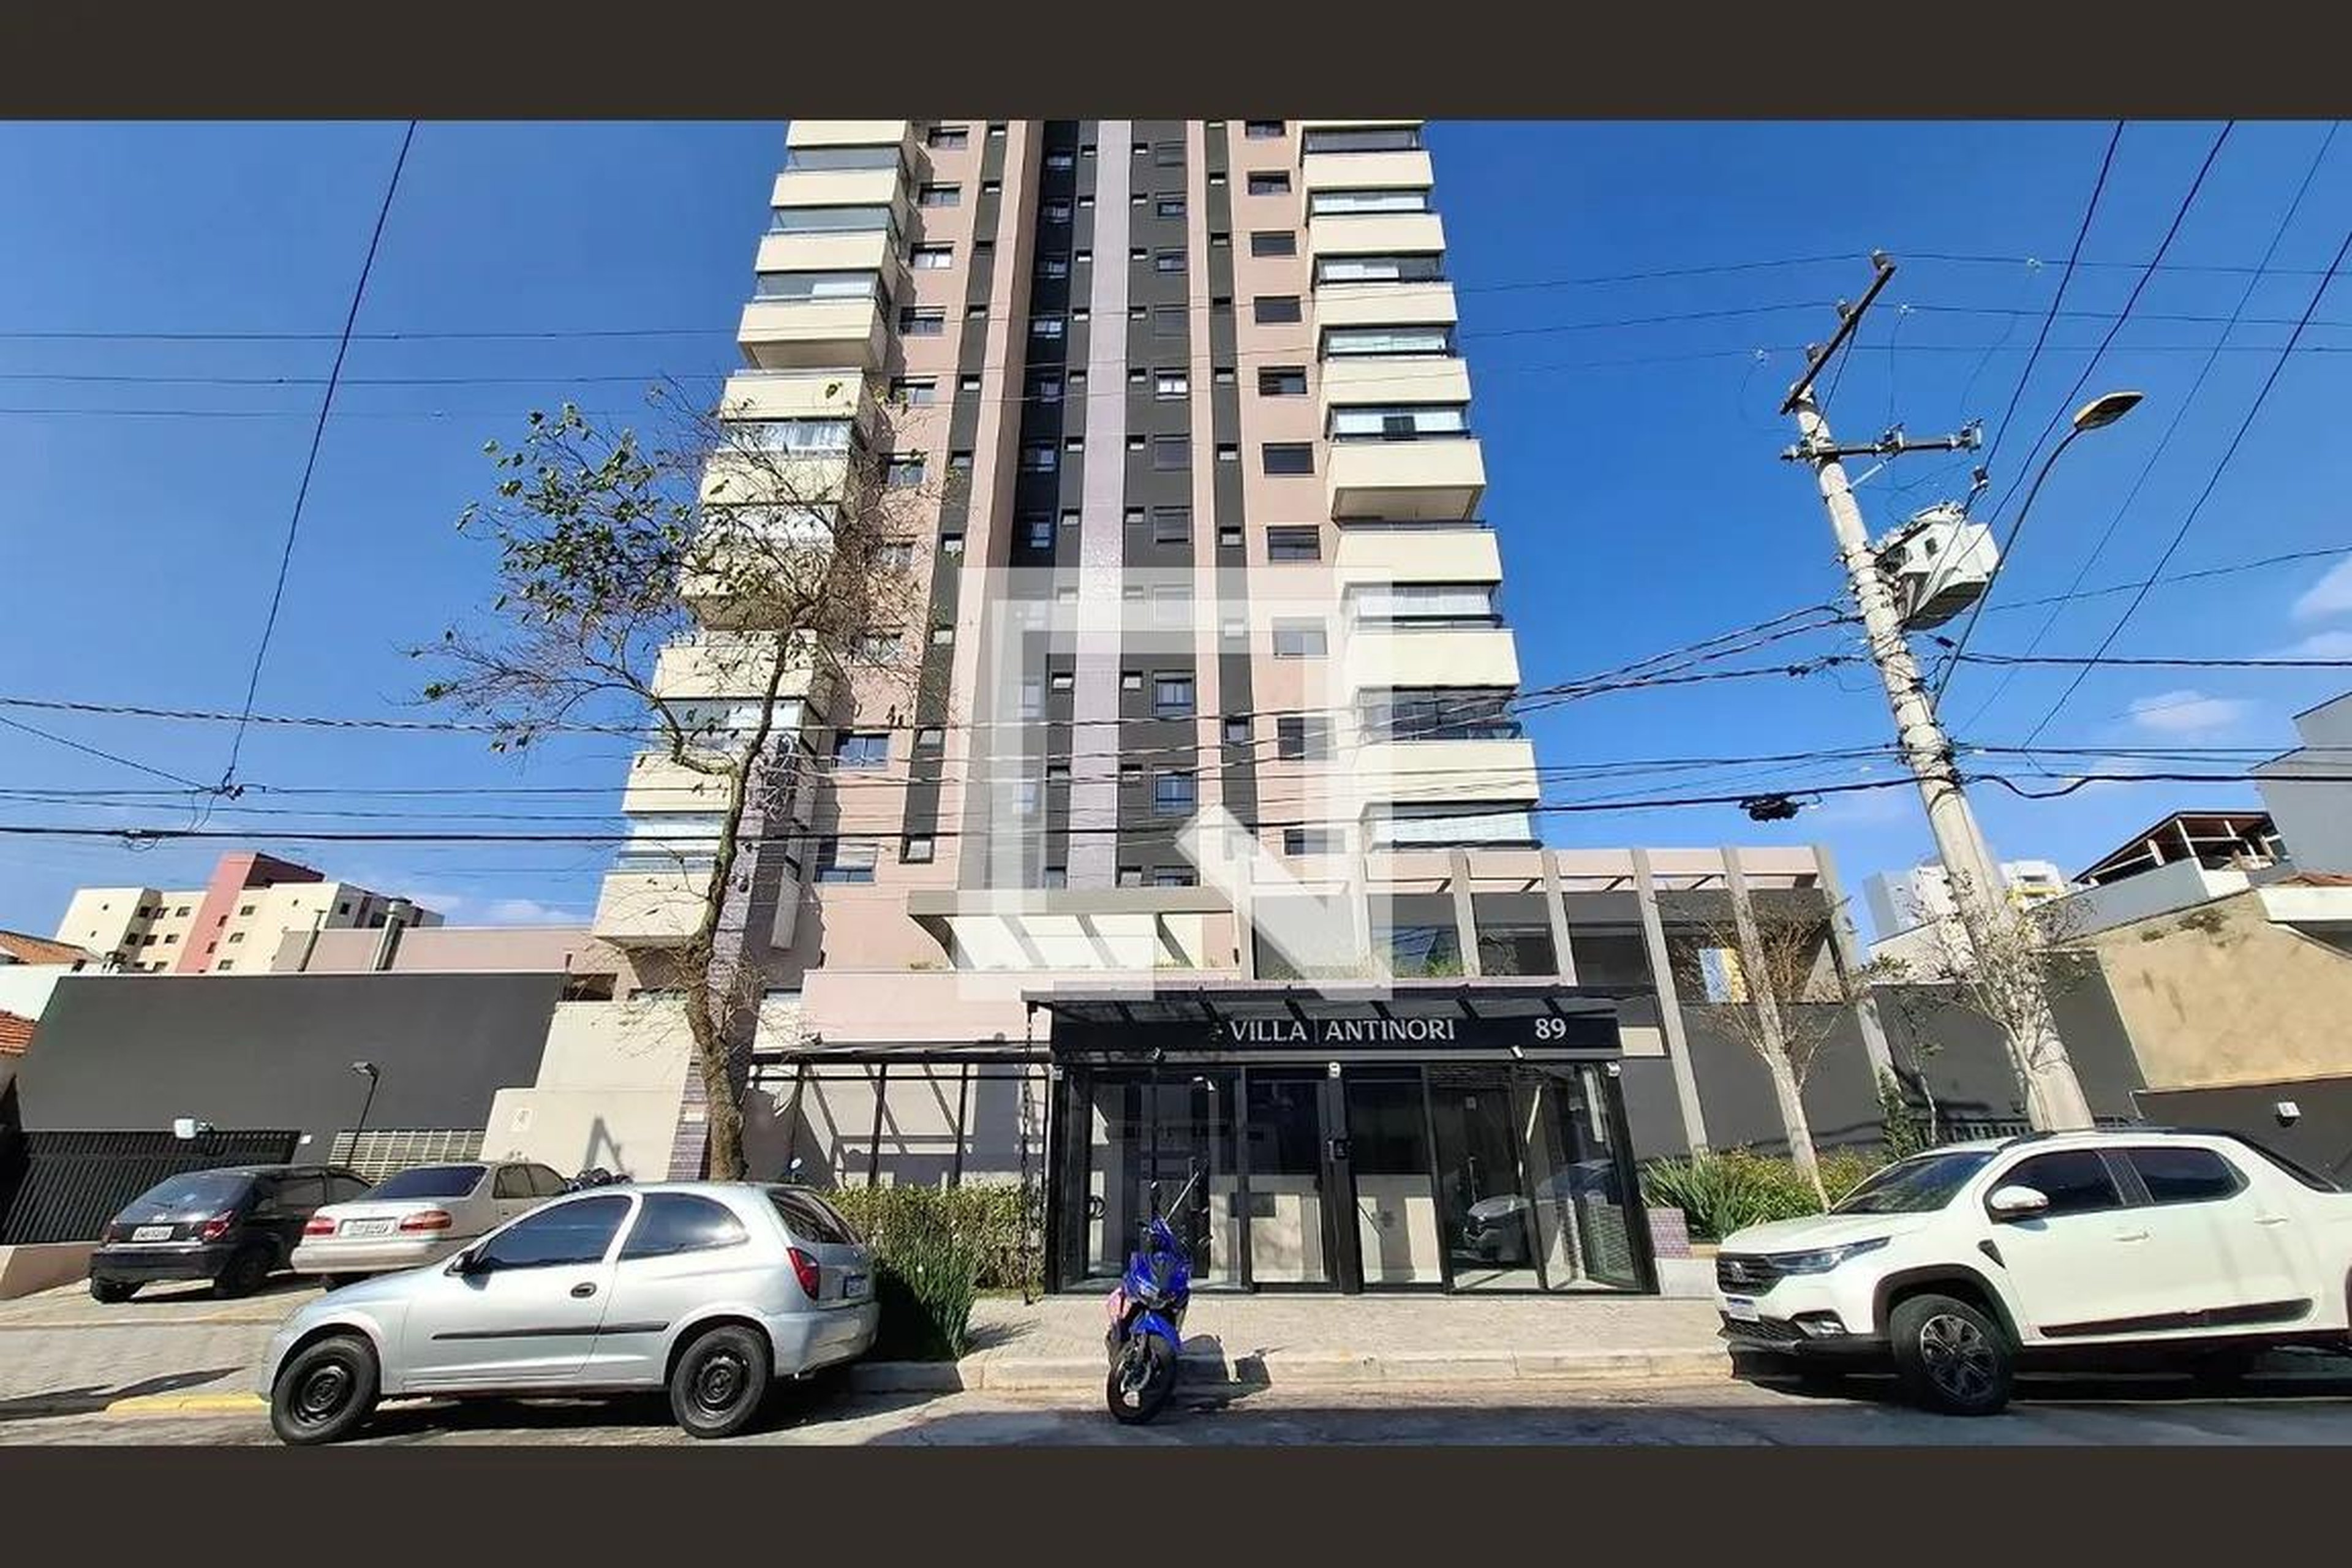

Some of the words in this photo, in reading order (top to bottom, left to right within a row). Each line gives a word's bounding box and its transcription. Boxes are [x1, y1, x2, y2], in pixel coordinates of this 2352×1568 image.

[1230, 1020, 1307, 1041] VILLA
[1325, 1019, 1454, 1041] ANTINORI
[1535, 1018, 1567, 1039] 89
